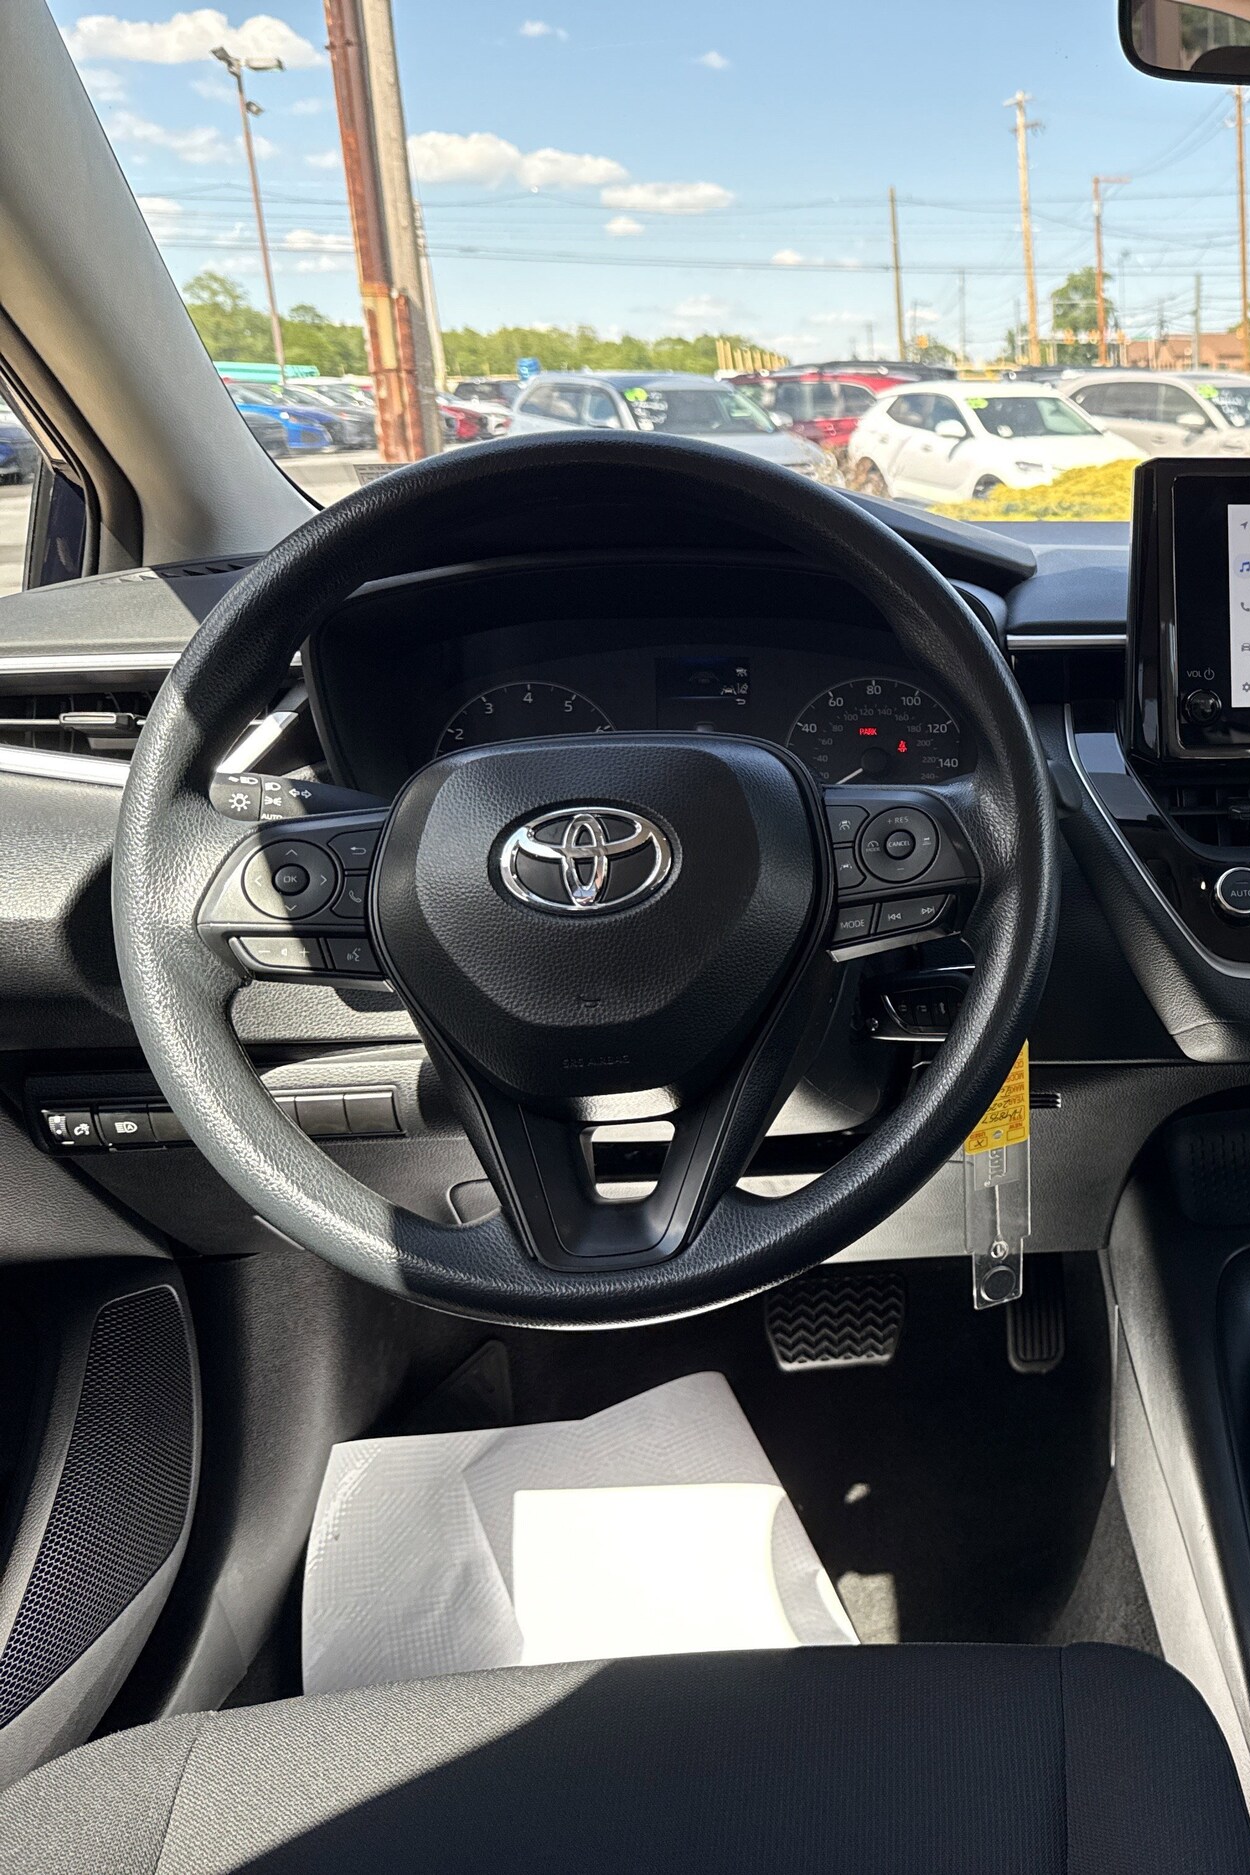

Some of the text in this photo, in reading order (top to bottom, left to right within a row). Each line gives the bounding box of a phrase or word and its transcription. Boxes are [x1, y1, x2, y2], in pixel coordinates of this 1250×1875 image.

[1186, 670, 1202, 678] VOL
[866, 685, 882, 695] 80
[522, 693, 533, 704] 4
[828, 696, 844, 707] 60
[901, 696, 921, 706] 100
[484, 703, 494, 715] 3
[564, 701, 573, 713] 5
[801, 723, 817, 733] 40
[859, 728, 878, 736] PARK
[927, 724, 947, 733] 120
[454, 729, 464, 740] 2
[938, 758, 958, 768] 140
[894, 816, 909, 824] RES
[888, 840, 911, 848] CANCEL
[283, 875, 298, 884] OK
[840, 919, 864, 929] MODE
